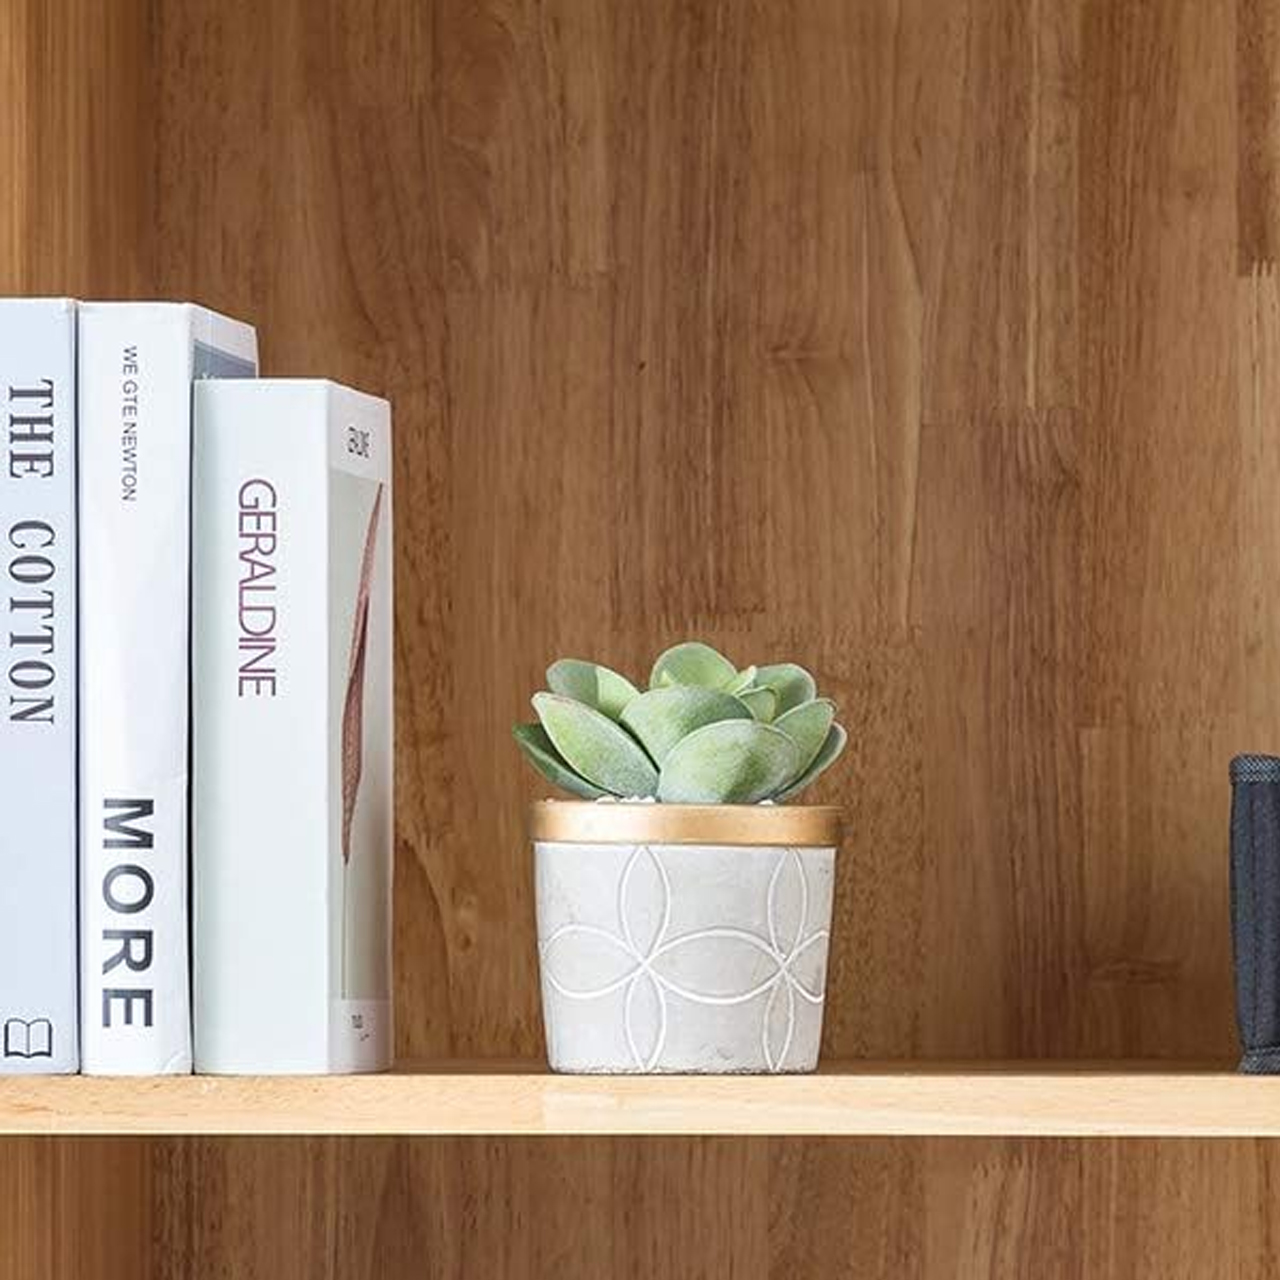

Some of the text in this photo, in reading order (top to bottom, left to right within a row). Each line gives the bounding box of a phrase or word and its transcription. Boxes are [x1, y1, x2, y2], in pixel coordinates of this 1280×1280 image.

[120, 422, 138, 502] NEWTON
[122, 345, 138, 375] WE
[8, 378, 56, 724] THE COTTON
[238, 478, 277, 697] GERALDINE
[102, 798, 154, 1028] MORE
